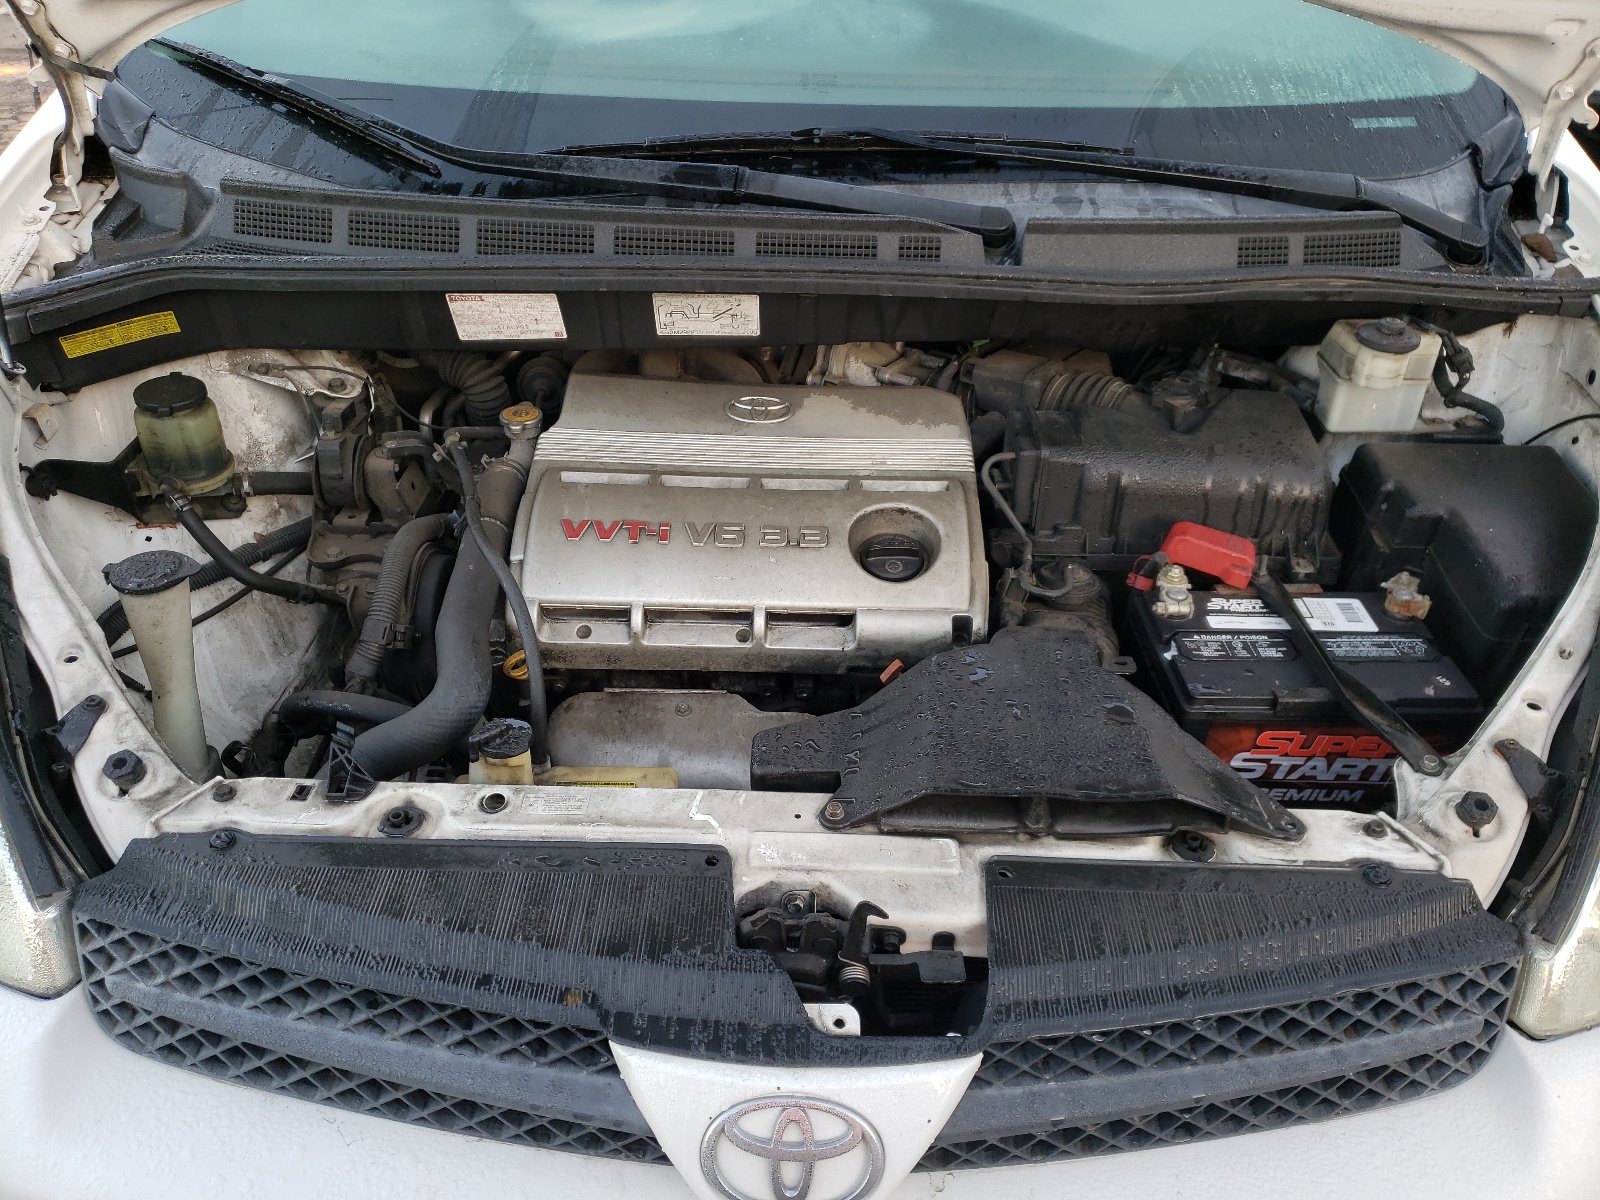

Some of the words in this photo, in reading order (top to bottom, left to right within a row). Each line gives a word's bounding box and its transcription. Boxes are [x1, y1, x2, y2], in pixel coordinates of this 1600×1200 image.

[561, 518, 671, 544] VVT-i
[684, 522, 745, 548] V6
[759, 525, 829, 548] 3.3
[1207, 602, 1264, 610] START
[1211, 597, 1263, 606] SUPER
[1229, 751, 1396, 781] START
[1260, 787, 1365, 802] EMIUM
